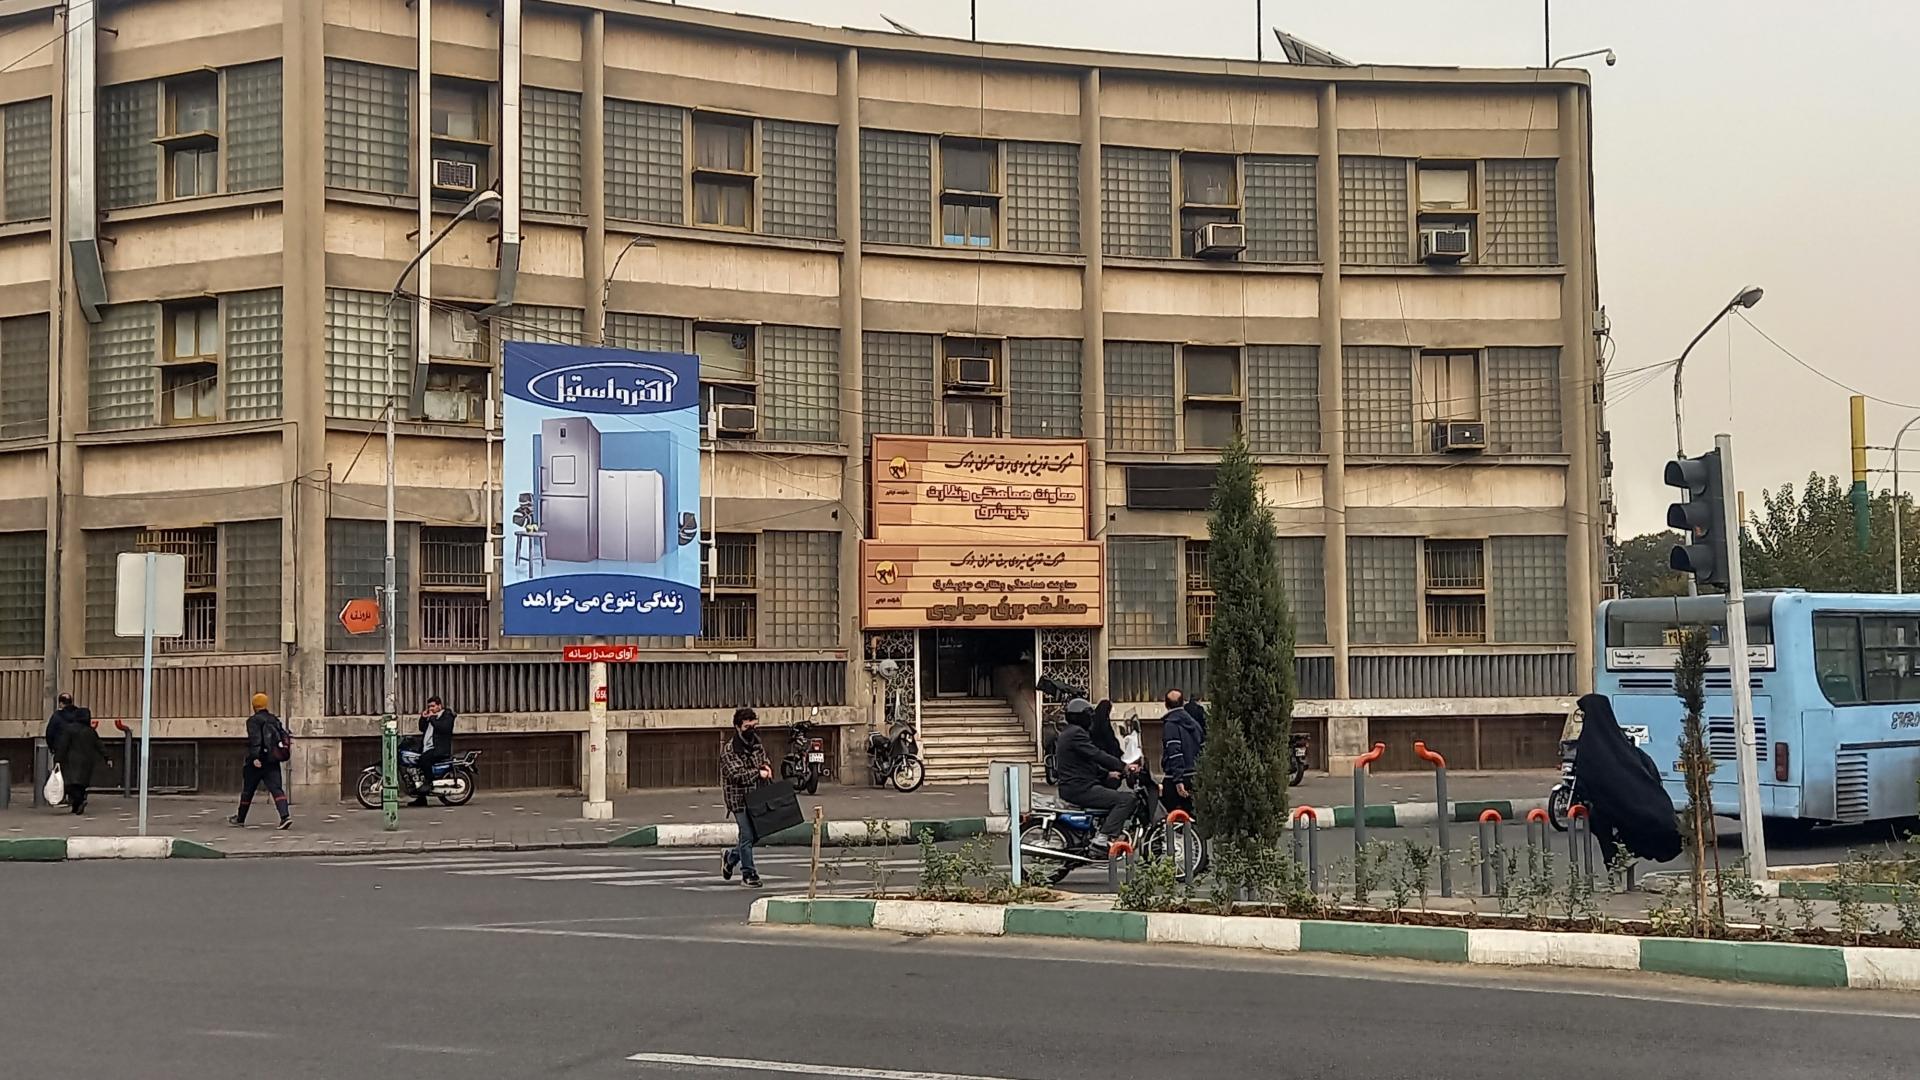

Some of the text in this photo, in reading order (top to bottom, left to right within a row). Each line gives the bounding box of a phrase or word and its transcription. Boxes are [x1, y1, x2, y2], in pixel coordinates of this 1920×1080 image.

[944, 450, 1074, 477] شرکت توزیع نیروی برق تهران بزرگ
[972, 485, 1032, 502] هماهنگی
[1033, 487, 1077, 503] معاونت
[950, 550, 1065, 571] شرکت توزیع نیروی برق تهران بزرگ
[601, 591, 636, 613] تنوع
[636, 590, 684, 613] زندگی
[926, 595, 1088, 621] منطقه برق مولوی
[568, 646, 634, 660] آوای صدرا رسانه
